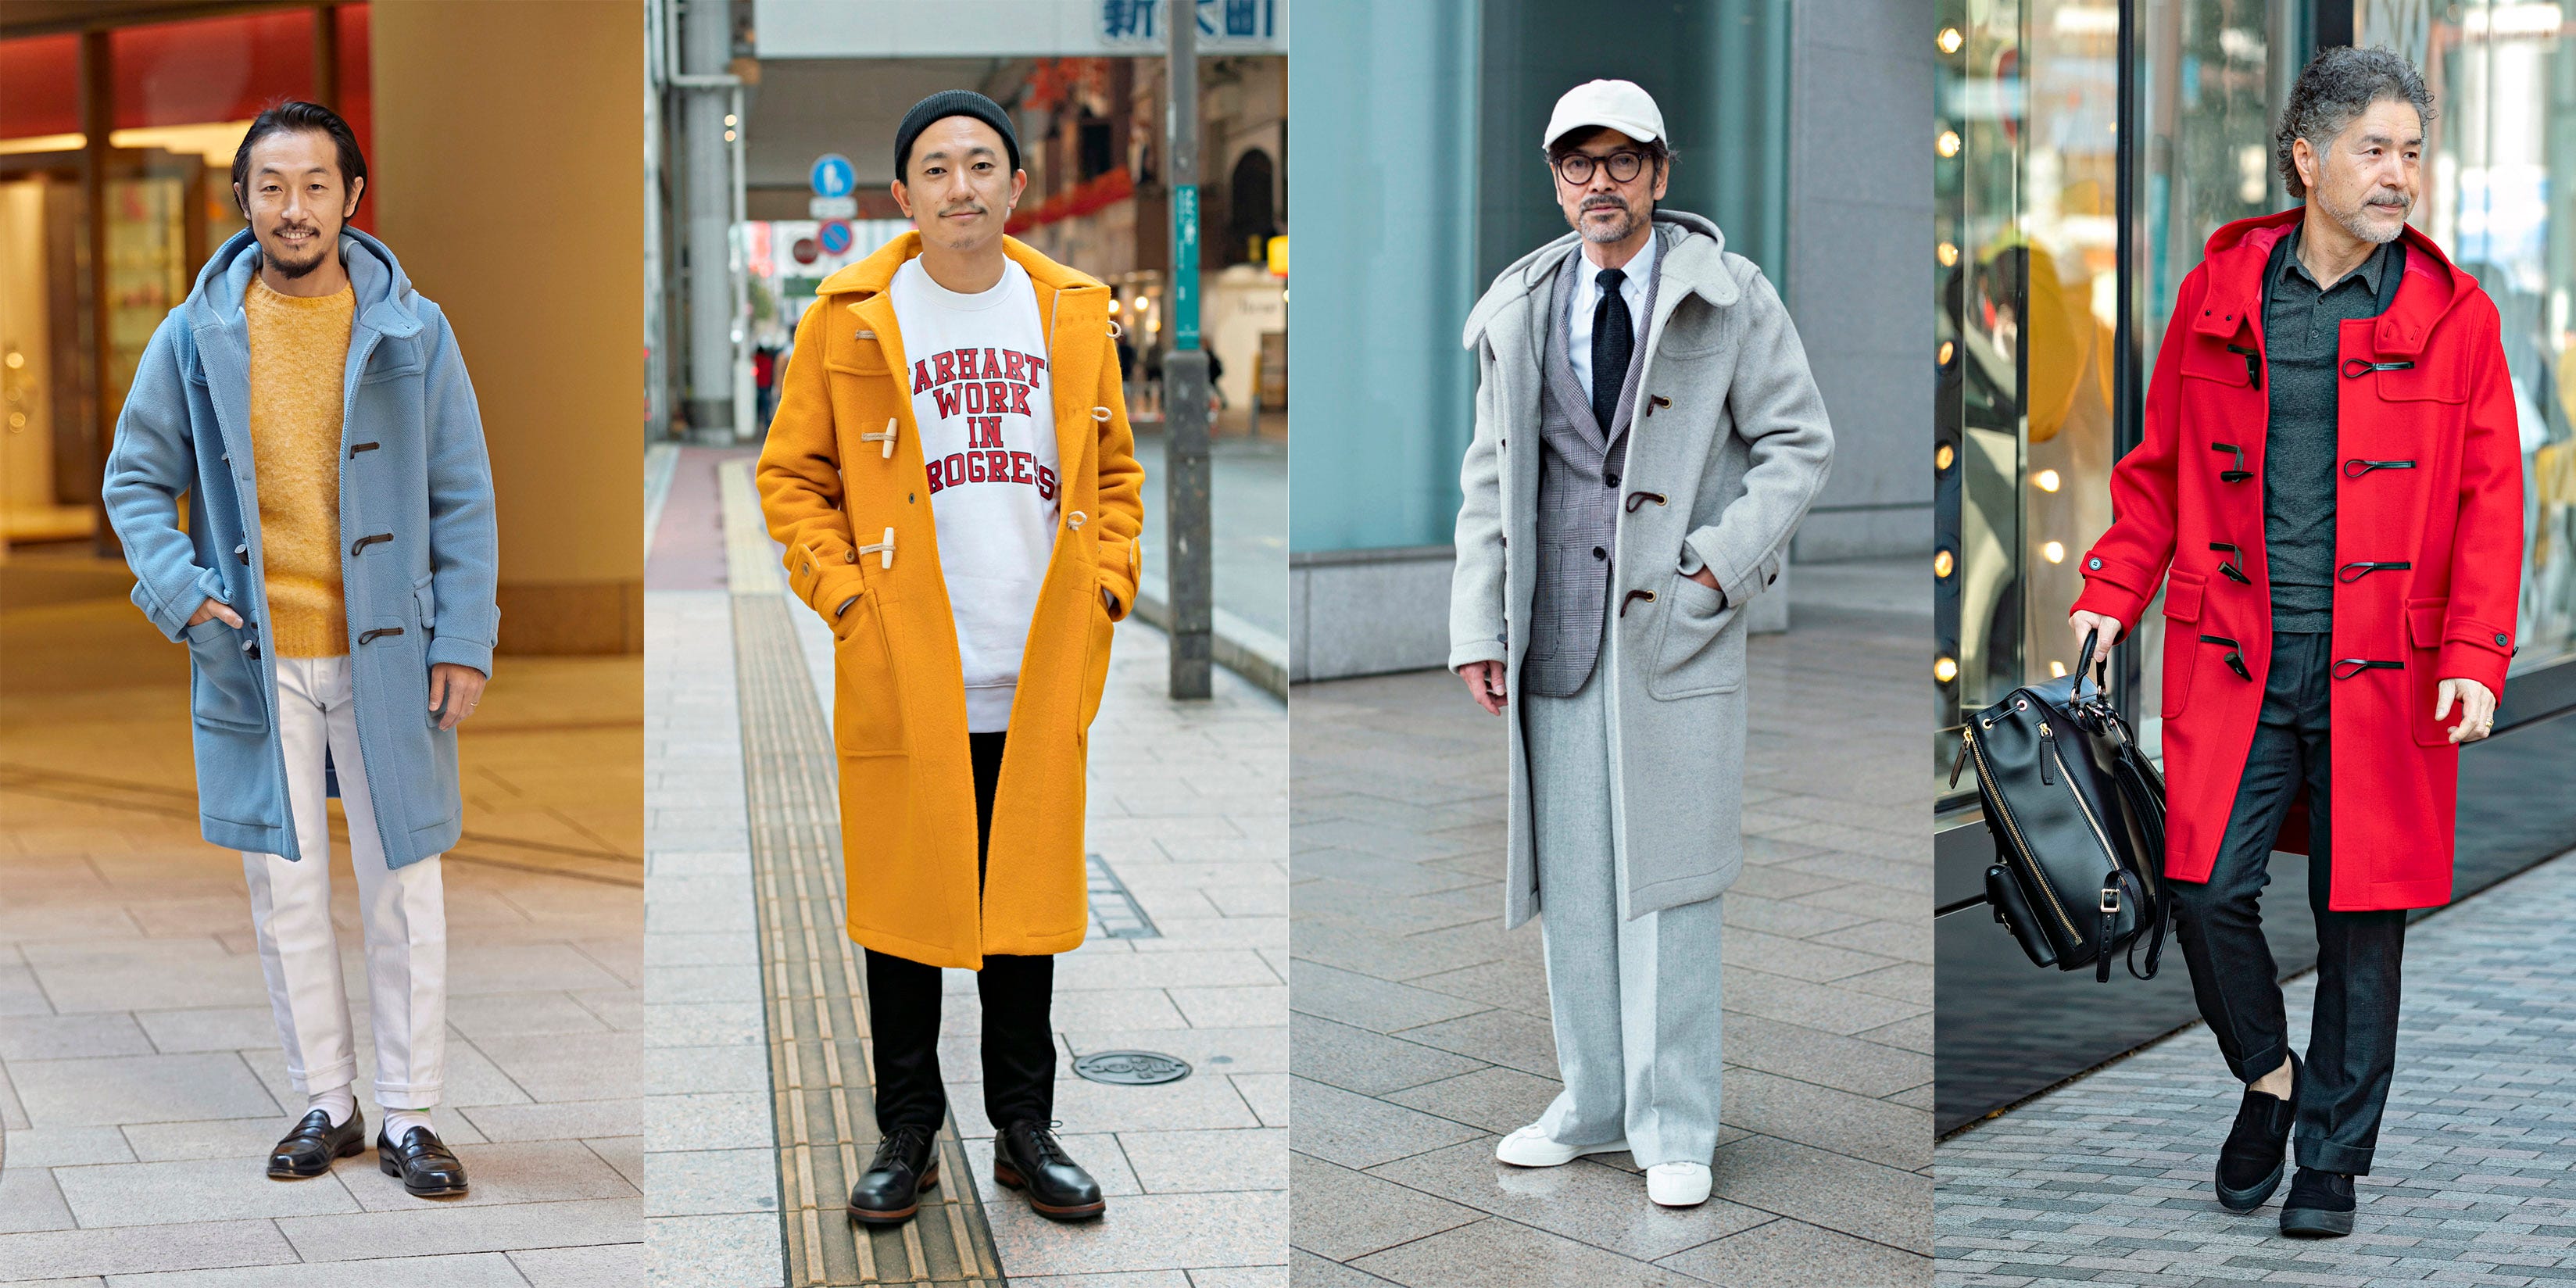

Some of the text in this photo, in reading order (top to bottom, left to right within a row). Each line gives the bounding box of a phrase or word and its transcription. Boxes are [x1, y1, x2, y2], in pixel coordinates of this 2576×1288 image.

[907, 348, 1052, 395] ARHART
[932, 381, 1032, 420] WORK
[967, 416, 1004, 449] IN
[925, 450, 1055, 501] ROGRES
